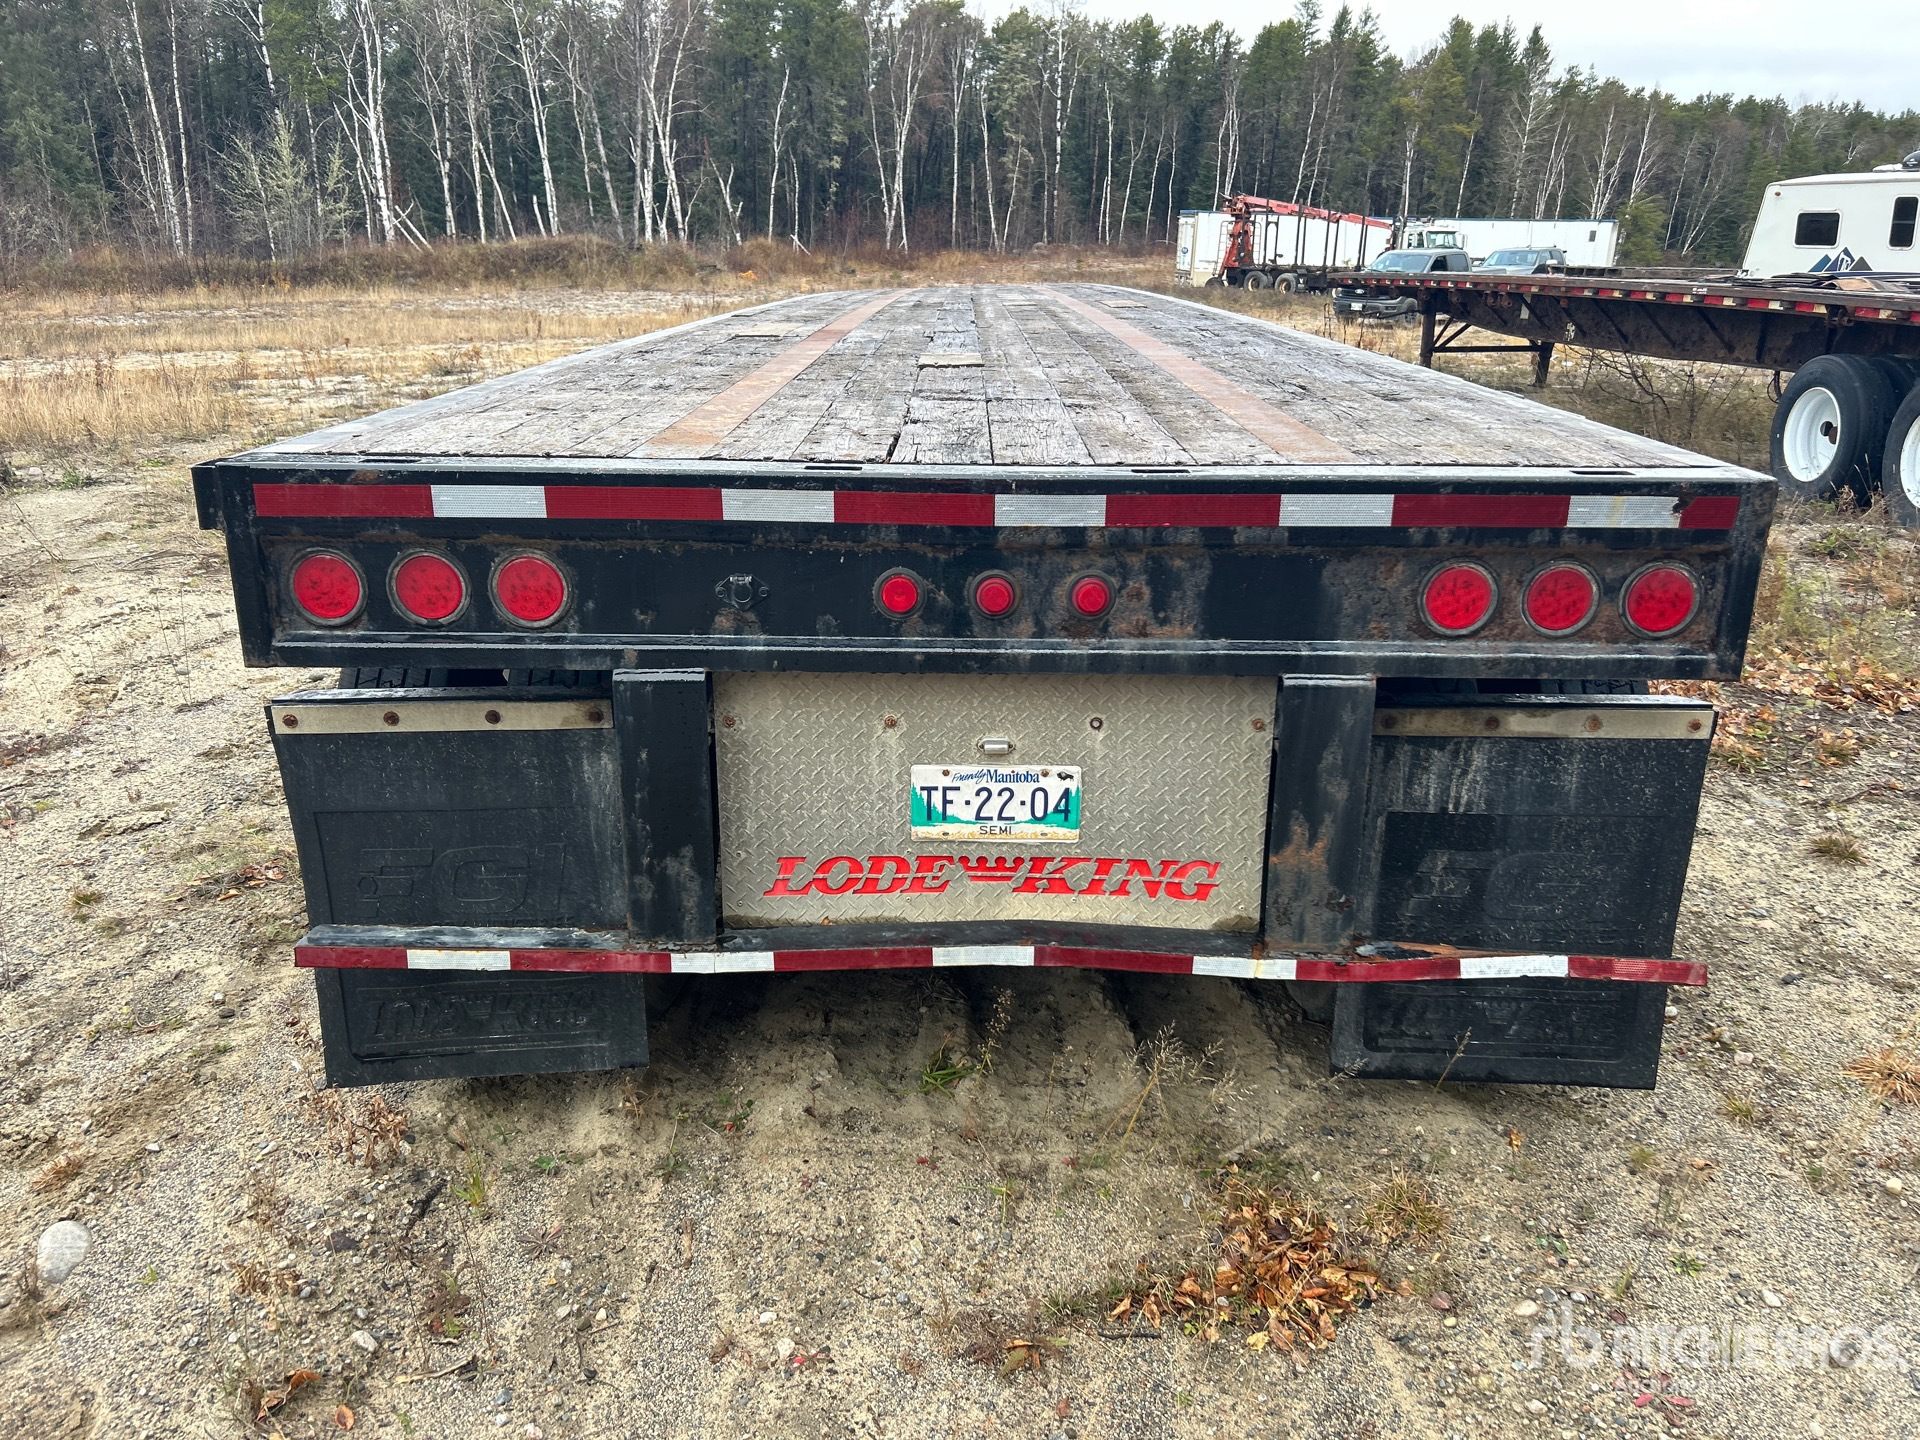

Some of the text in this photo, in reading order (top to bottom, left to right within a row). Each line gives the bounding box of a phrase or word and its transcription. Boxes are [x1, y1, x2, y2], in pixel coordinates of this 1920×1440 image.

[952, 769, 1040, 785] Friendly Manitoba
[979, 826, 1012, 835] SEMI
[763, 855, 1221, 902] LODE KING
